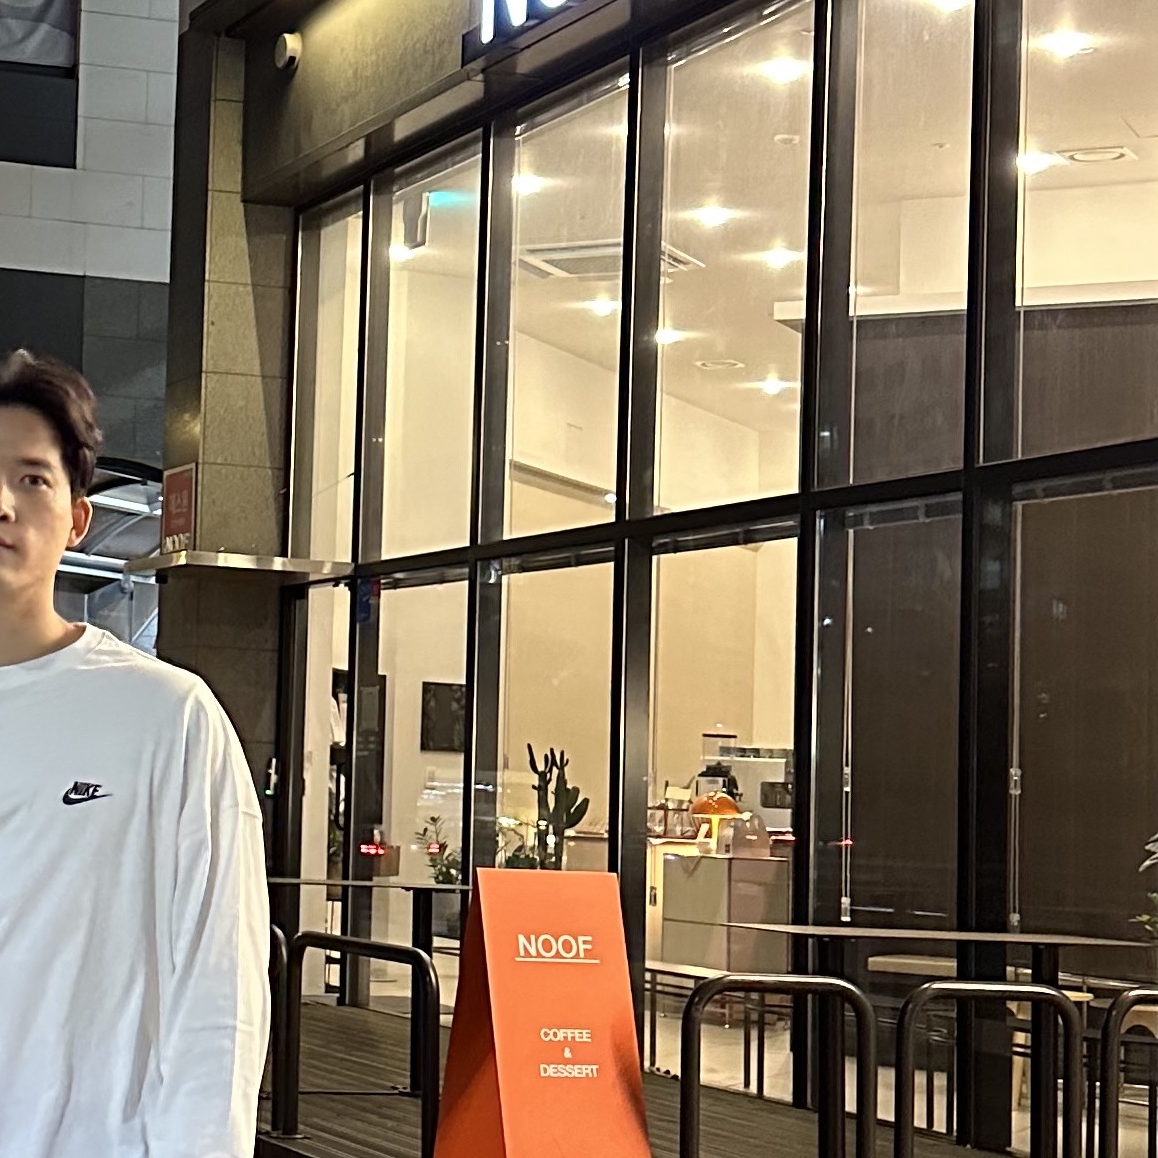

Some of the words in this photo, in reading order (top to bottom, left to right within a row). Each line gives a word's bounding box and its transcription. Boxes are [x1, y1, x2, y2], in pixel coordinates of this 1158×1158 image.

[517, 933, 593, 959] NOOF
[539, 1028, 592, 1043] COFFEE
[563, 1046, 573, 1059] &
[539, 1063, 600, 1078] DESSERT
